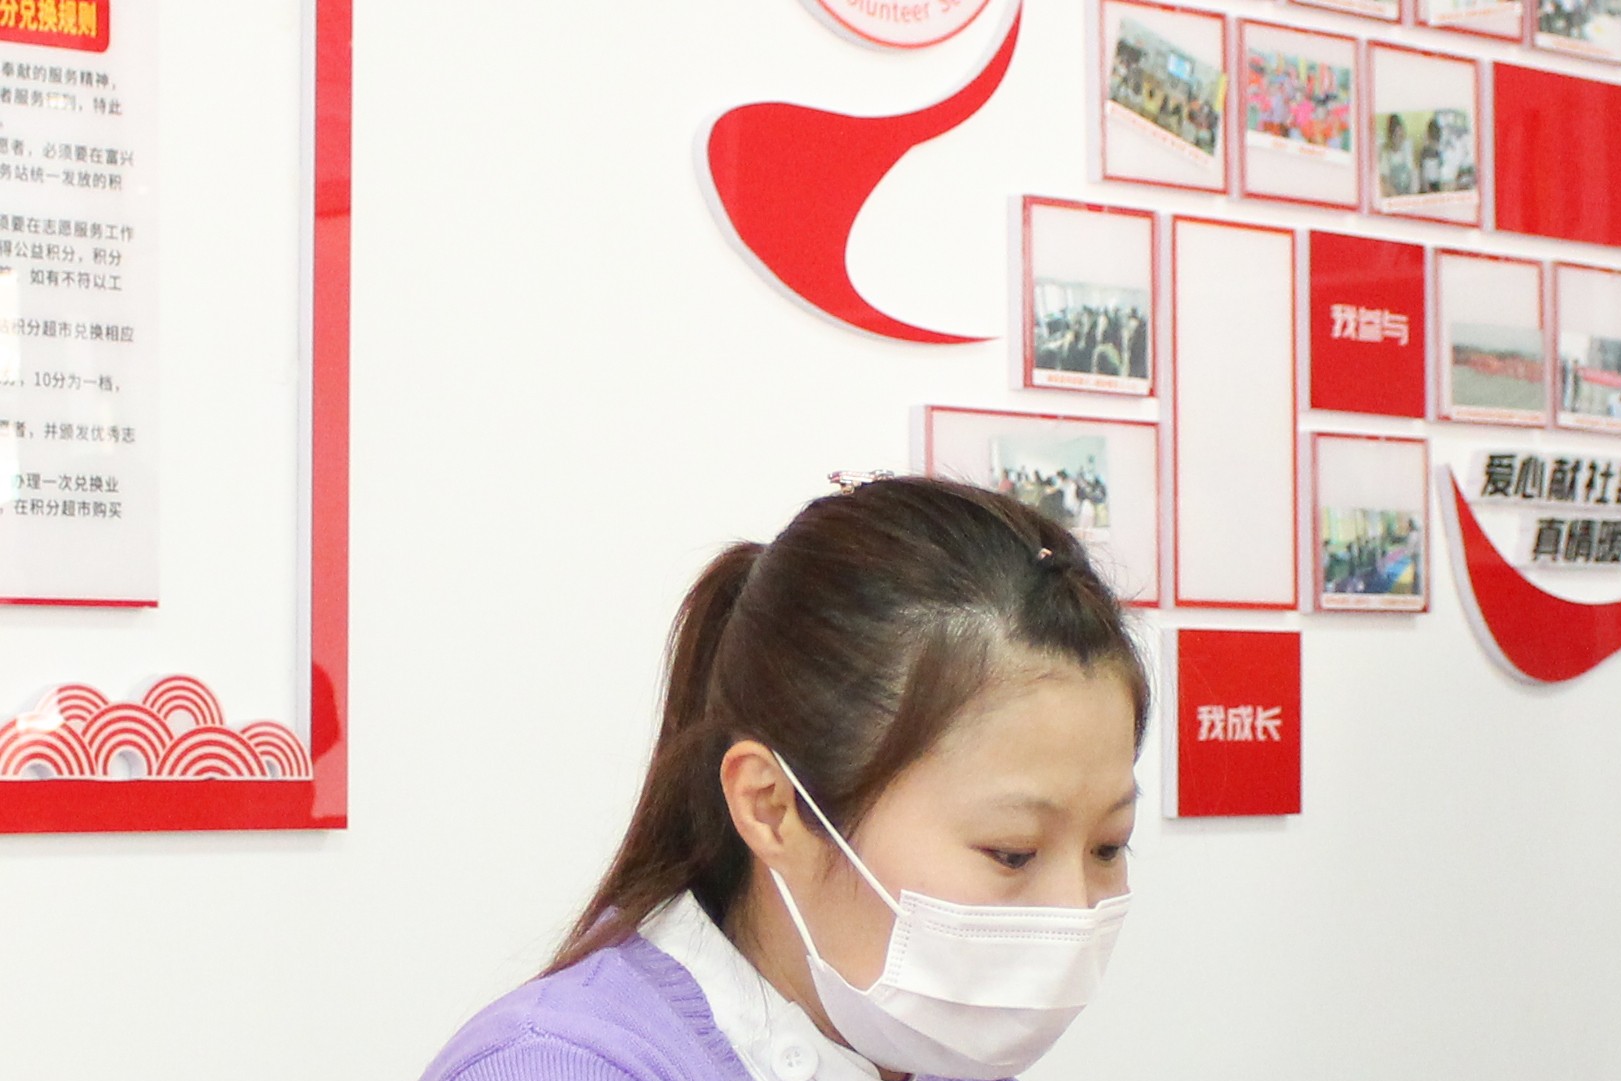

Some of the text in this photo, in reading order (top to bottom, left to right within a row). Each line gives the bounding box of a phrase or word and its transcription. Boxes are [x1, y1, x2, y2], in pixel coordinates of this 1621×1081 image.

[1330, 304, 1409, 346] 我参与
[1197, 705, 1283, 741] 我成长
